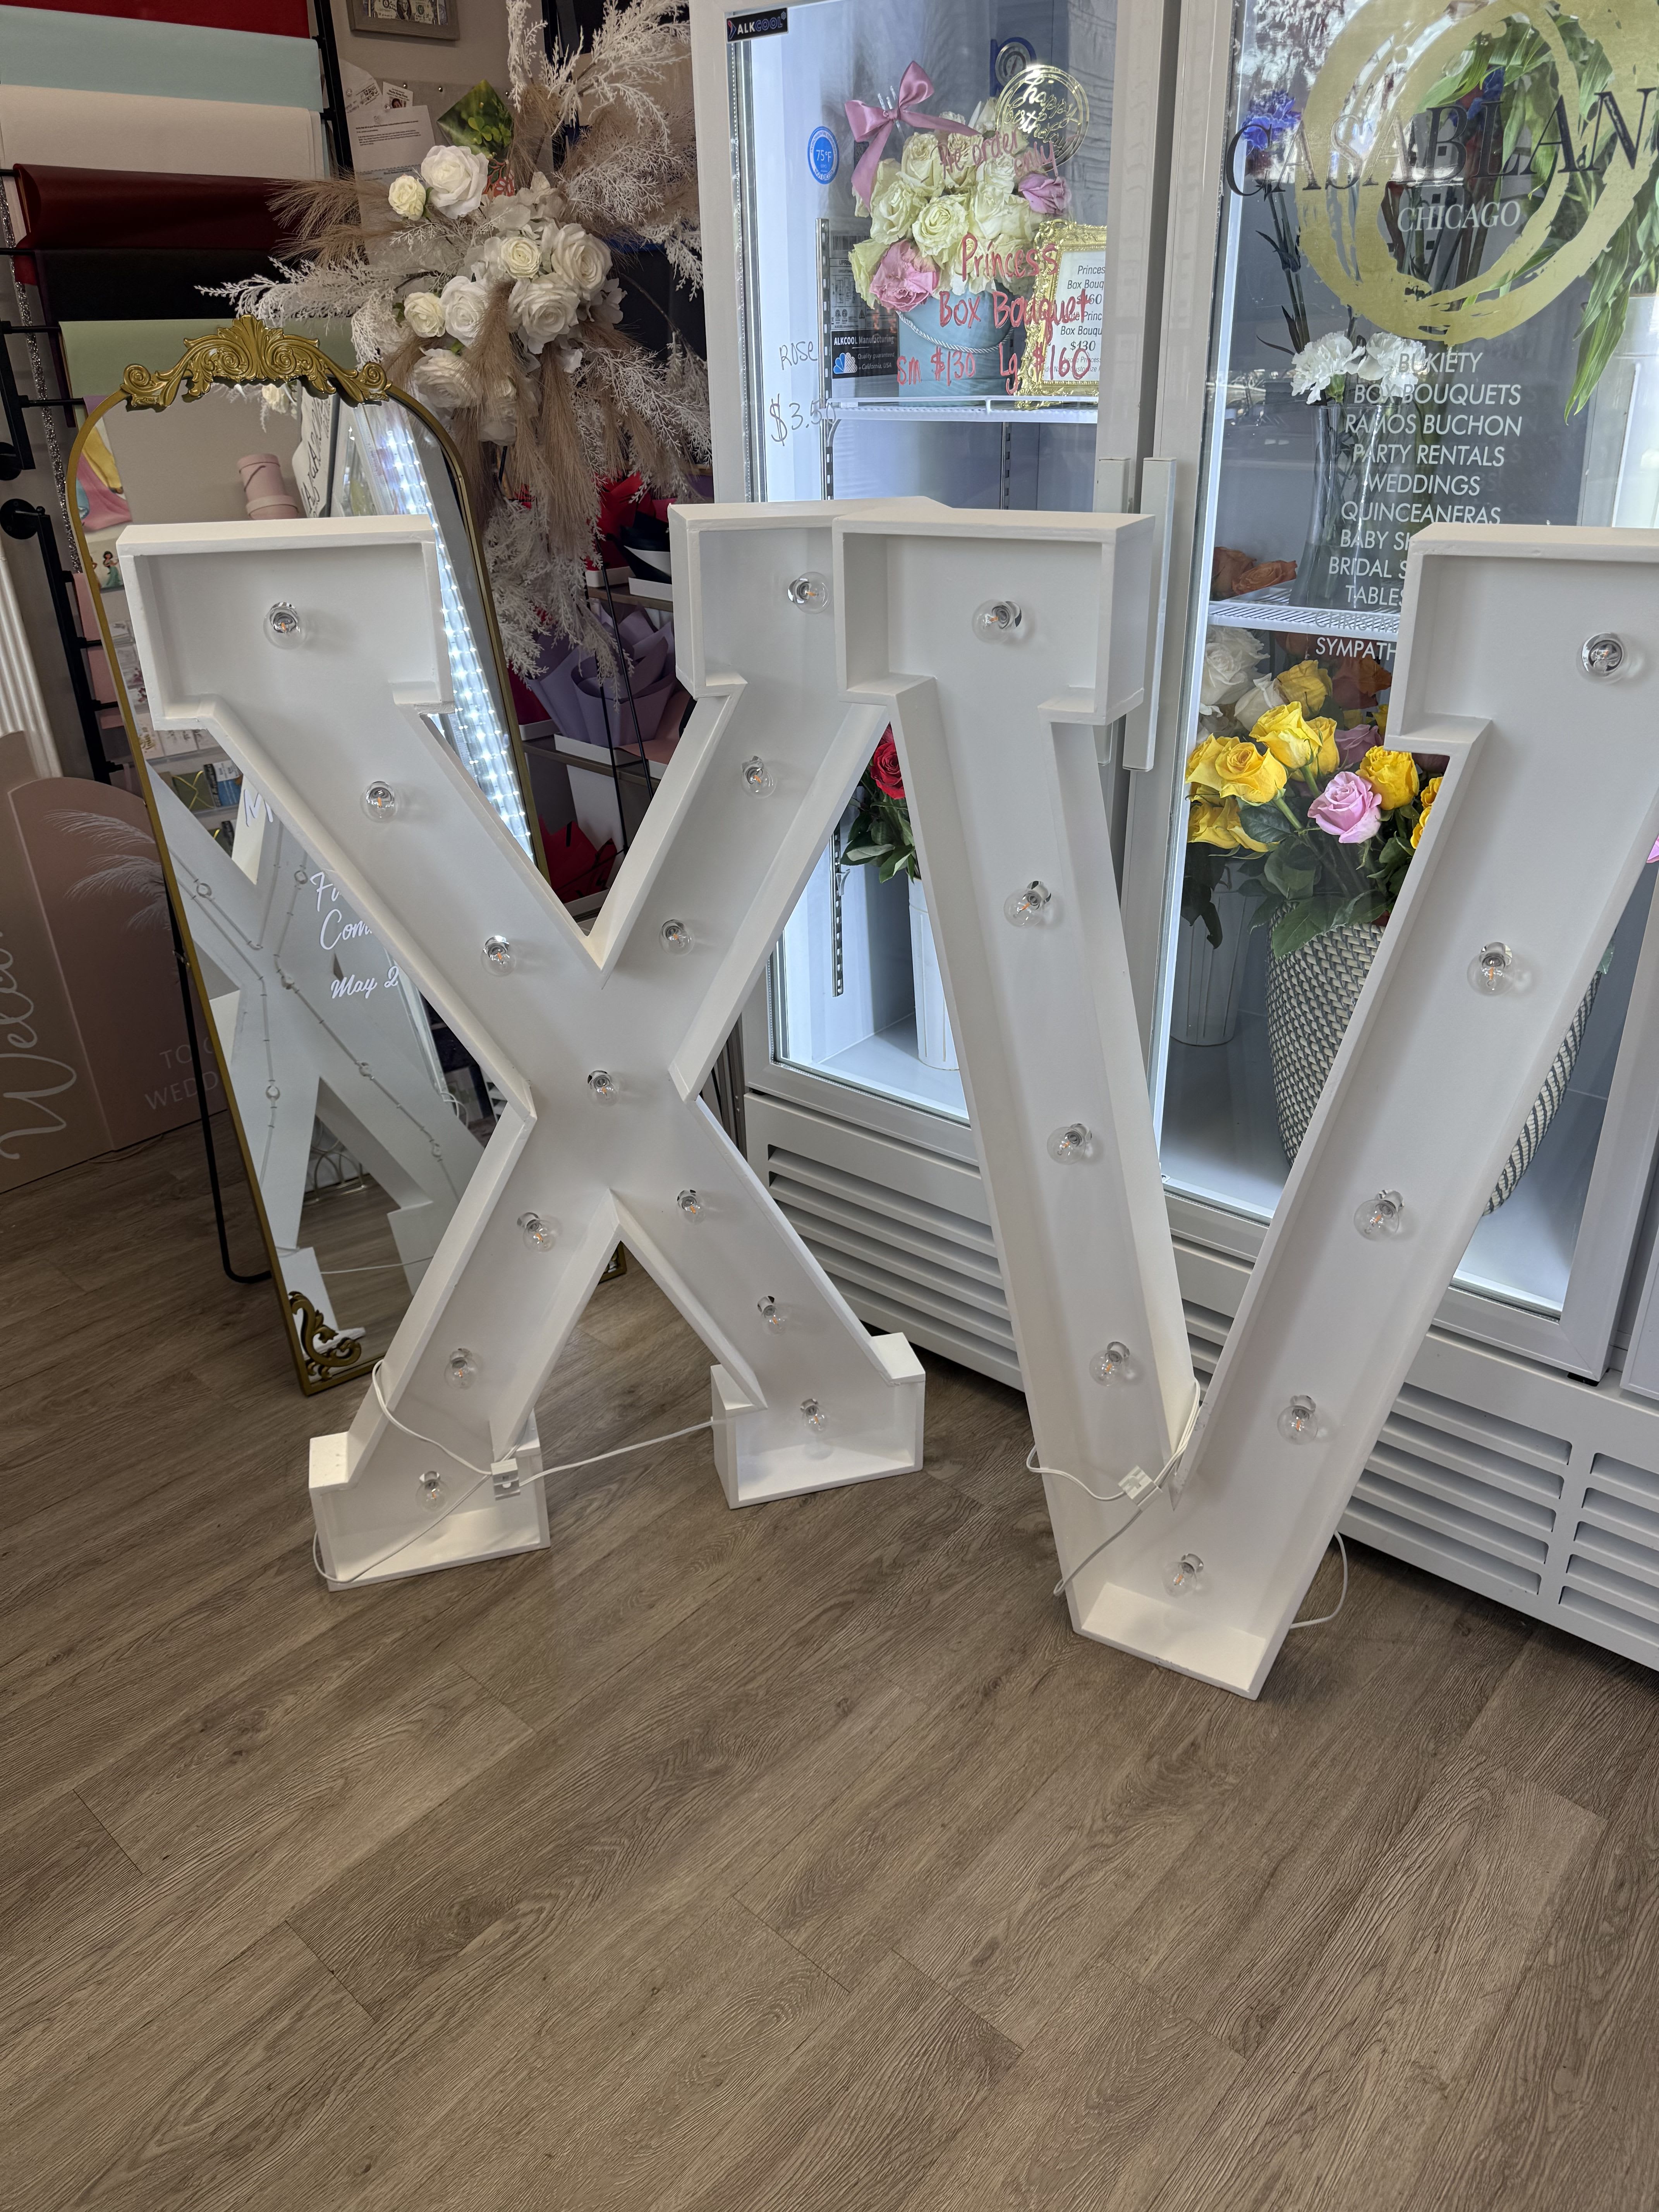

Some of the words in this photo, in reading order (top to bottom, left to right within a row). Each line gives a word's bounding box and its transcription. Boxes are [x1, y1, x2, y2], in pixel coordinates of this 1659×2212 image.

[737, 16, 782, 34] ALKCOOL
[1225, 88, 1659, 196] CASABLAN
[816, 149, 831, 162] 75°F
[1397, 201, 1520, 232] CHICAGO
[962, 232, 1058, 282] Princess
[1067, 280, 1082, 289] Box
[939, 291, 981, 329] Box
[993, 289, 1092, 344] Bouquet
[834, 336, 858, 345] ALKCOOL
[859, 334, 894, 345] Manufacturing
[1061, 326, 1075, 335] Box
[931, 346, 975, 386] $130
[999, 342, 1018, 395] Lg
[1033, 342, 1091, 381] $160
[1398, 352, 1483, 373] BUKIETY
[1354, 384, 1395, 404] BOX
[1402, 383, 1521, 405] BOUQUETS
[770, 393, 836, 446] $3.50
[1345, 414, 1416, 434] RAMOS
[1423, 414, 1522, 437] BUCHON
[1353, 444, 1412, 464] PARTY
[1417, 445, 1504, 467] RENTALS
[1369, 473, 1480, 496] WEDDINGS
[1341, 501, 1501, 524] QUINCEANERAS
[1340, 529, 1389, 549] BABY
[1329, 556, 1392, 578] BRIDAL
[1316, 611, 1399, 633] CHRISTM
[331, 974, 378, 999] May
[159, 1044, 192, 1069] TO
